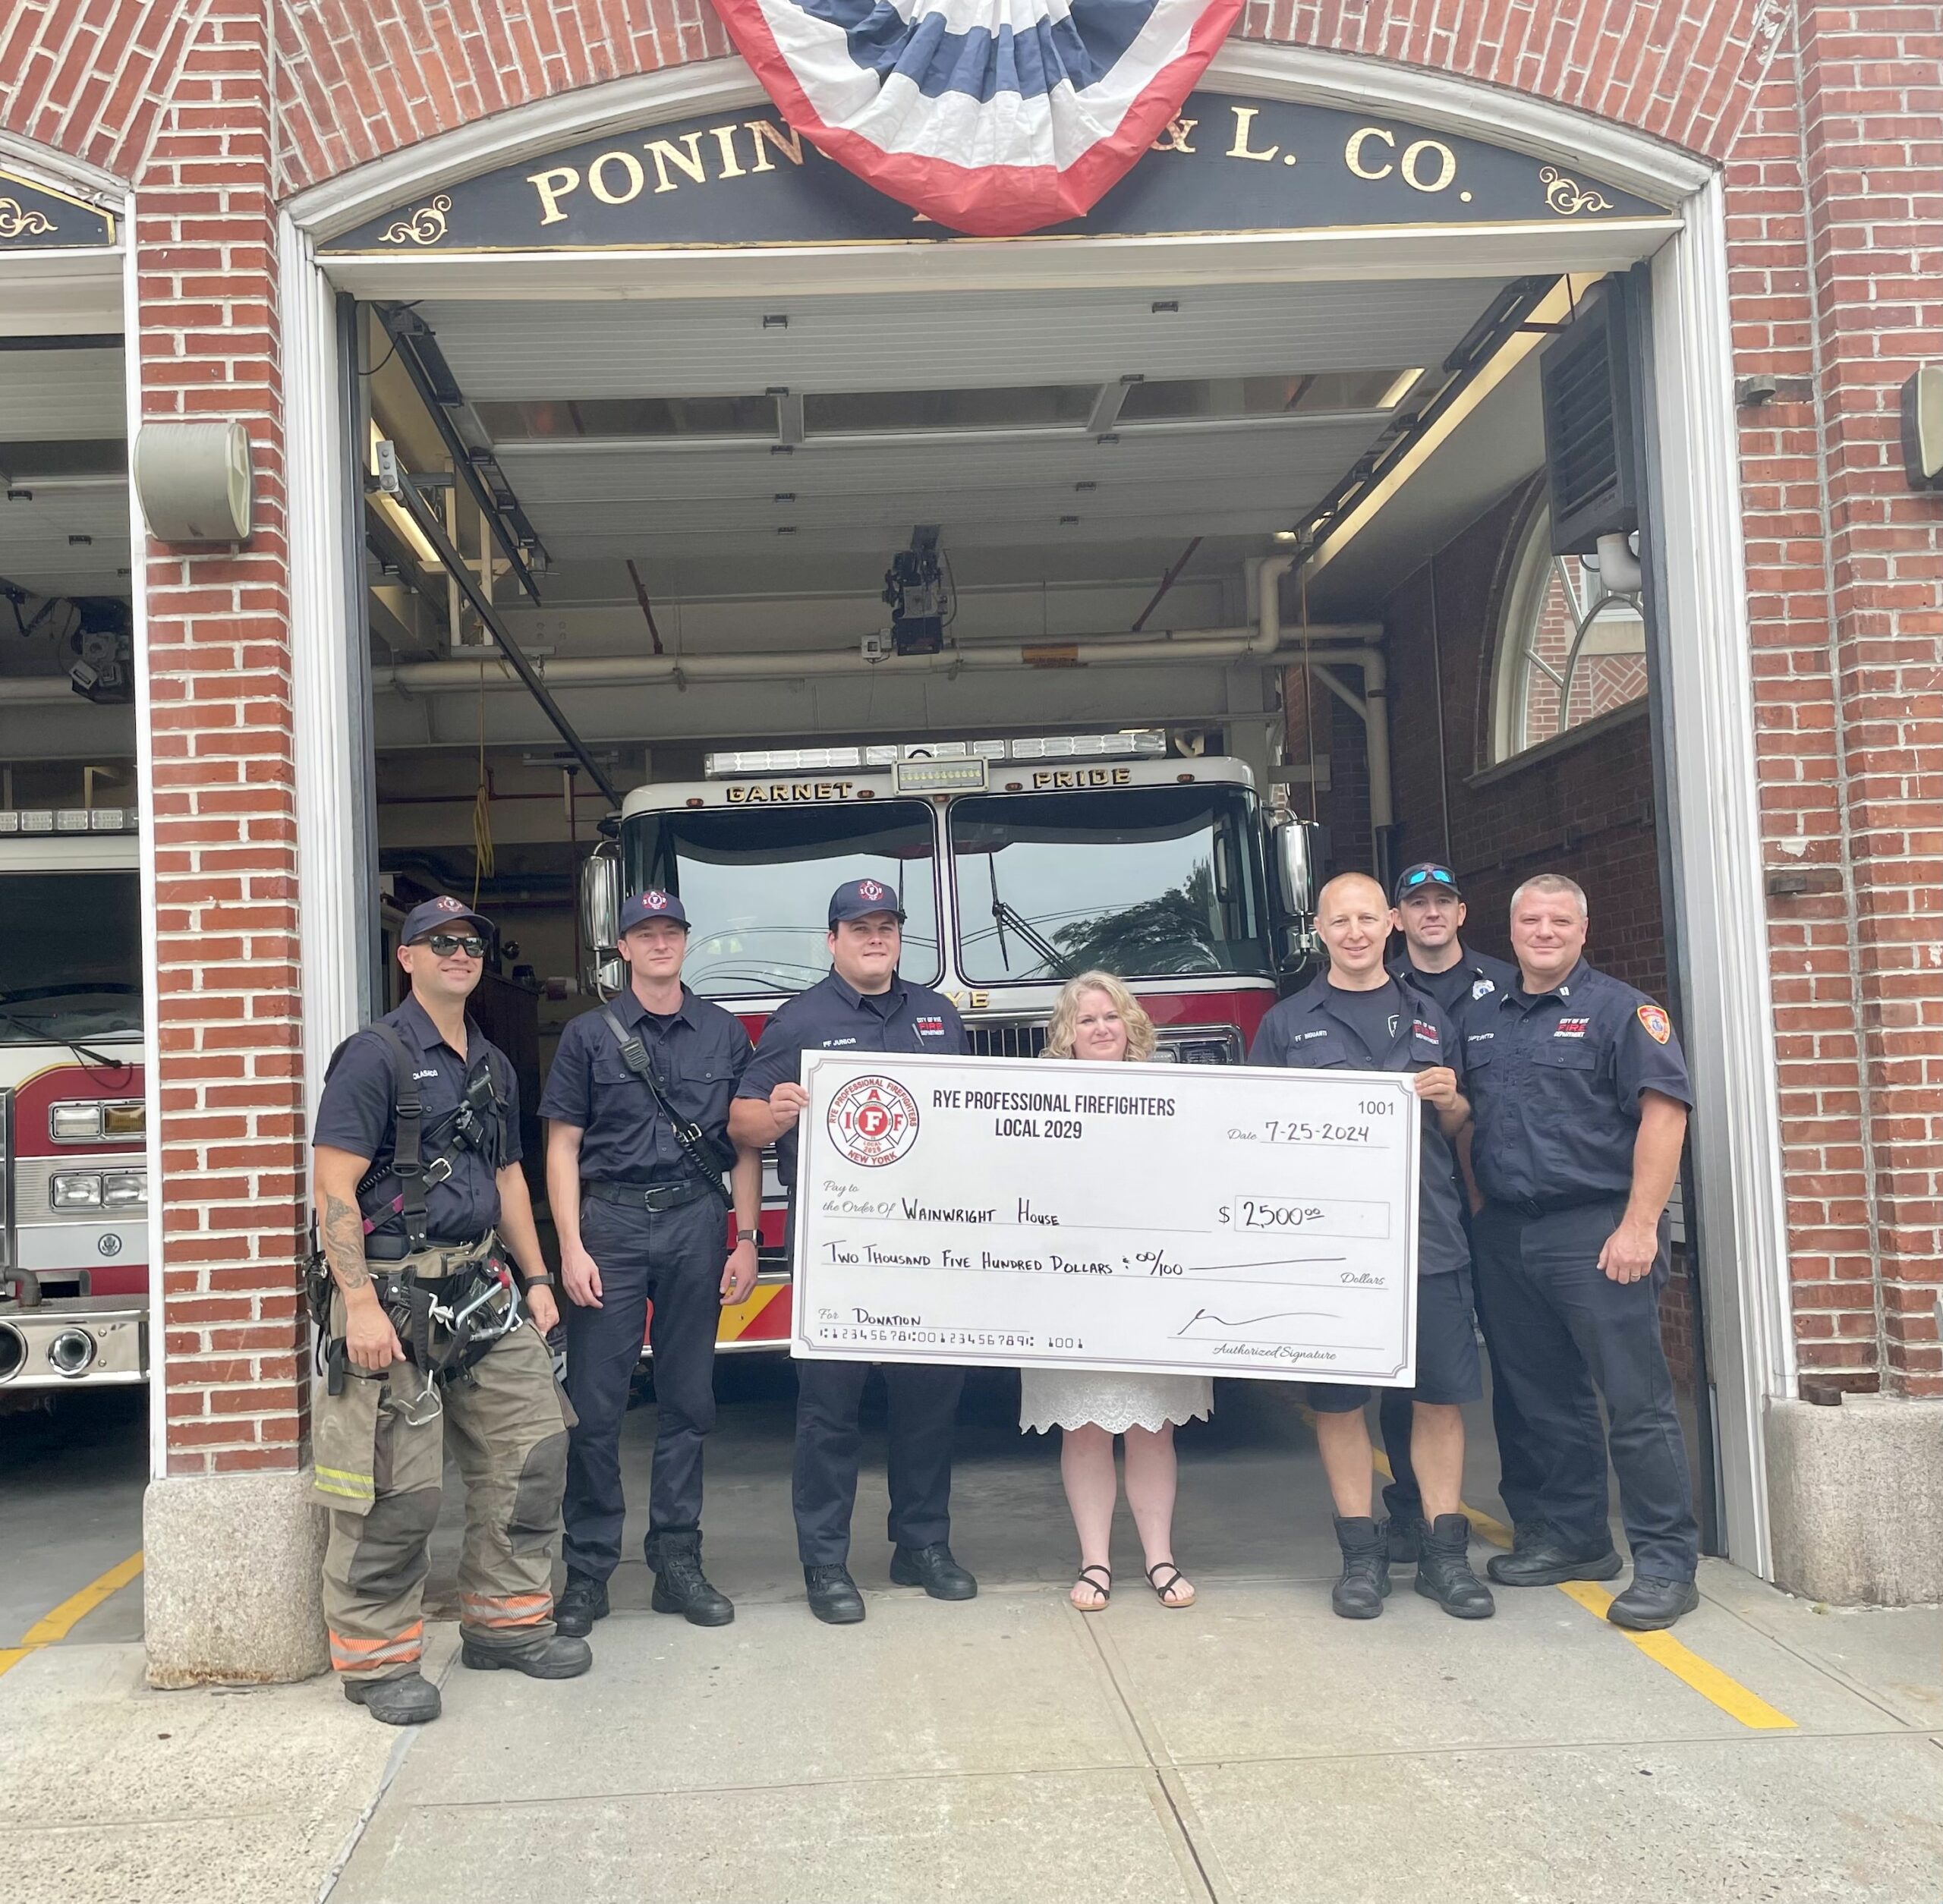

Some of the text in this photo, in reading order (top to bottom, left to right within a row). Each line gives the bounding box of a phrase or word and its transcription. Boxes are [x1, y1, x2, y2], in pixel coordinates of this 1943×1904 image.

[527, 116, 835, 226] PONIN
[1225, 105, 1297, 165] L.
[1344, 127, 1473, 203] CO.
[726, 768, 1132, 802] GARNET PRIDE
[942, 990, 990, 1009] YE
[833, 1037, 856, 1046] JUNIOR
[829, 1078, 917, 1127] RYE PROFESSIONAL FIREFIGHTERS
[933, 1090, 1176, 1116] RYE PROFESSIONAL FIREFIGHTERS
[1358, 1101, 1394, 1116] 1001
[995, 1119, 1082, 1139] LOCAL 2029
[1227, 1128, 1257, 1140] Date
[1265, 1121, 1369, 1142] 7-25-2024
[847, 1150, 897, 1165] NEW YORK
[823, 1181, 860, 1197] Pay to
[823, 1201, 896, 1219] the Order Of
[1219, 1206, 1230, 1225] $
[1340, 1273, 1385, 1286] Dollars
[818, 1308, 839, 1320] For
[1048, 1336, 1084, 1350] 1001
[1214, 1343, 1337, 1362] Authorized Signature
